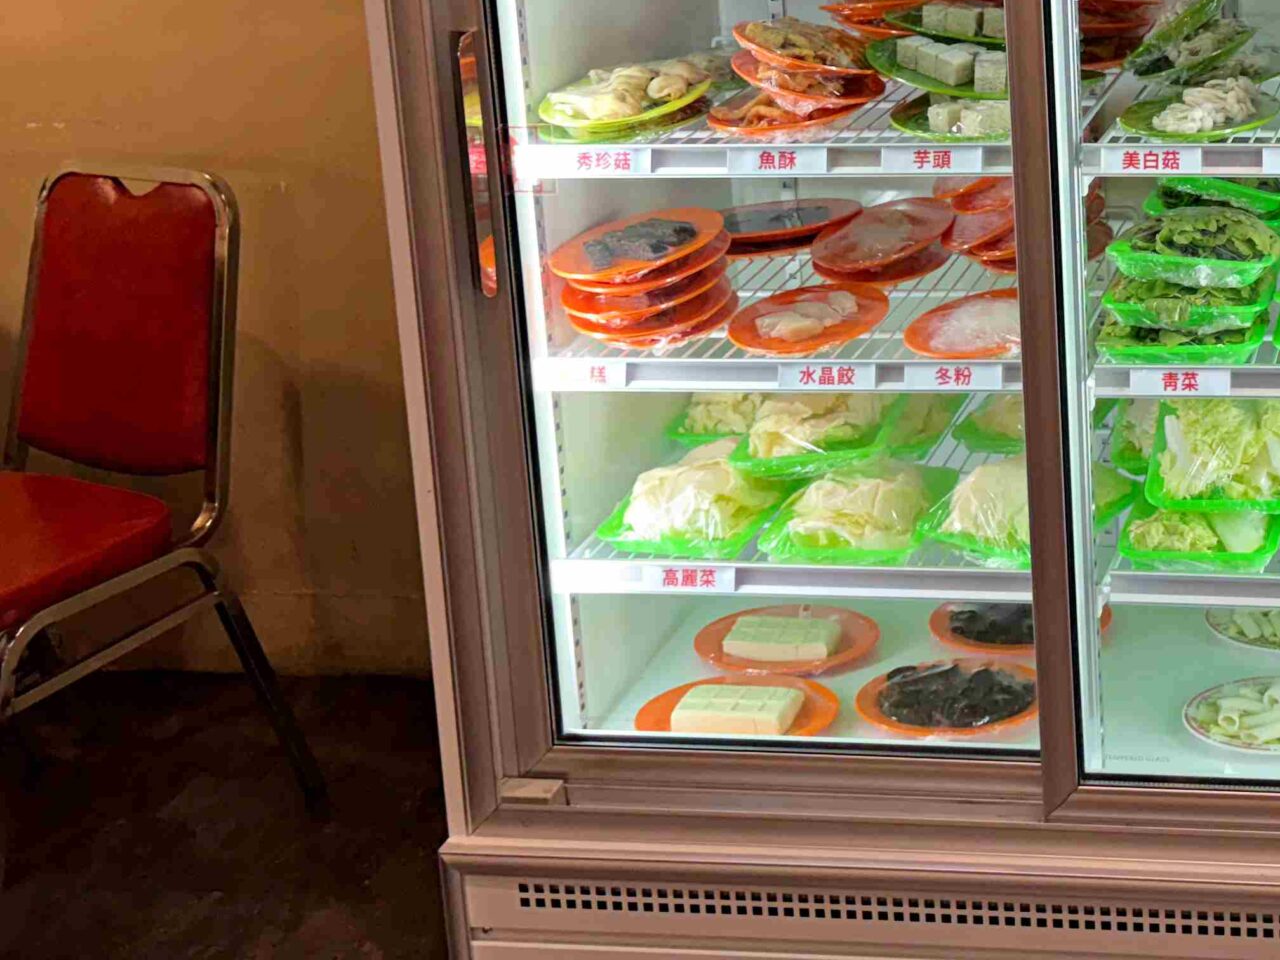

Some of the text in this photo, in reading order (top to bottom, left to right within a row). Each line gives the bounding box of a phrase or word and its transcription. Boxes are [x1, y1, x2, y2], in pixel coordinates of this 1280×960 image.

[577, 151, 631, 171] 秀珍菇
[758, 150, 797, 170] 魚酥
[913, 149, 952, 170] 芋頭
[1122, 149, 1181, 171] 美白菇
[799, 365, 856, 386] 水晶餃
[936, 365, 973, 387] 冬粉
[1161, 371, 1200, 392] 青菜
[662, 567, 717, 588] 高麗菜
